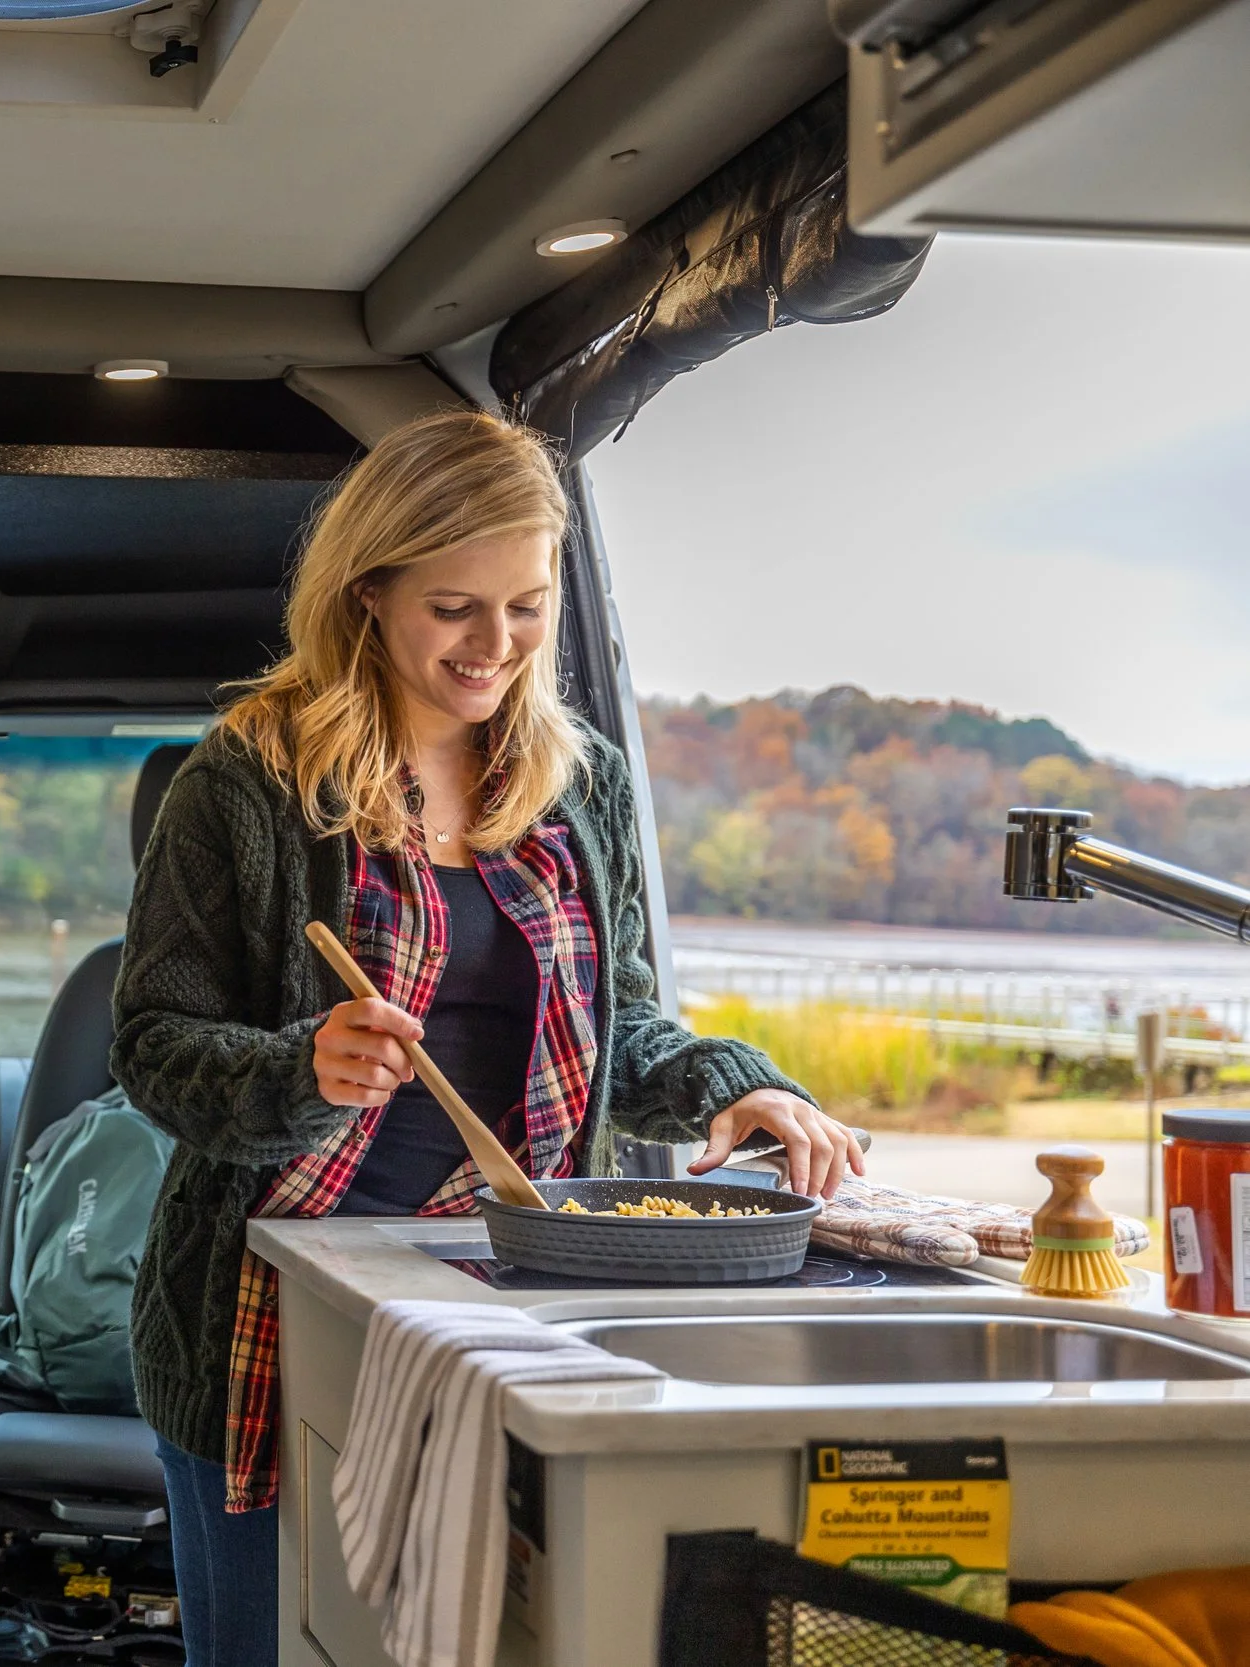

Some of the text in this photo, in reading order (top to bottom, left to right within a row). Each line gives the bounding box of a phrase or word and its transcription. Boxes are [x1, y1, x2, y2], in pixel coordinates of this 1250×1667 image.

[67, 1178, 97, 1256] CAMAK
[841, 1450, 893, 1461] NATIONAL
[841, 1461, 908, 1474] GEOGRAPHIC
[849, 1485, 963, 1506] Springer and
[820, 1506, 990, 1524] Cohutta Mountains
[886, 1559, 951, 1571] ILLUSTRATED
